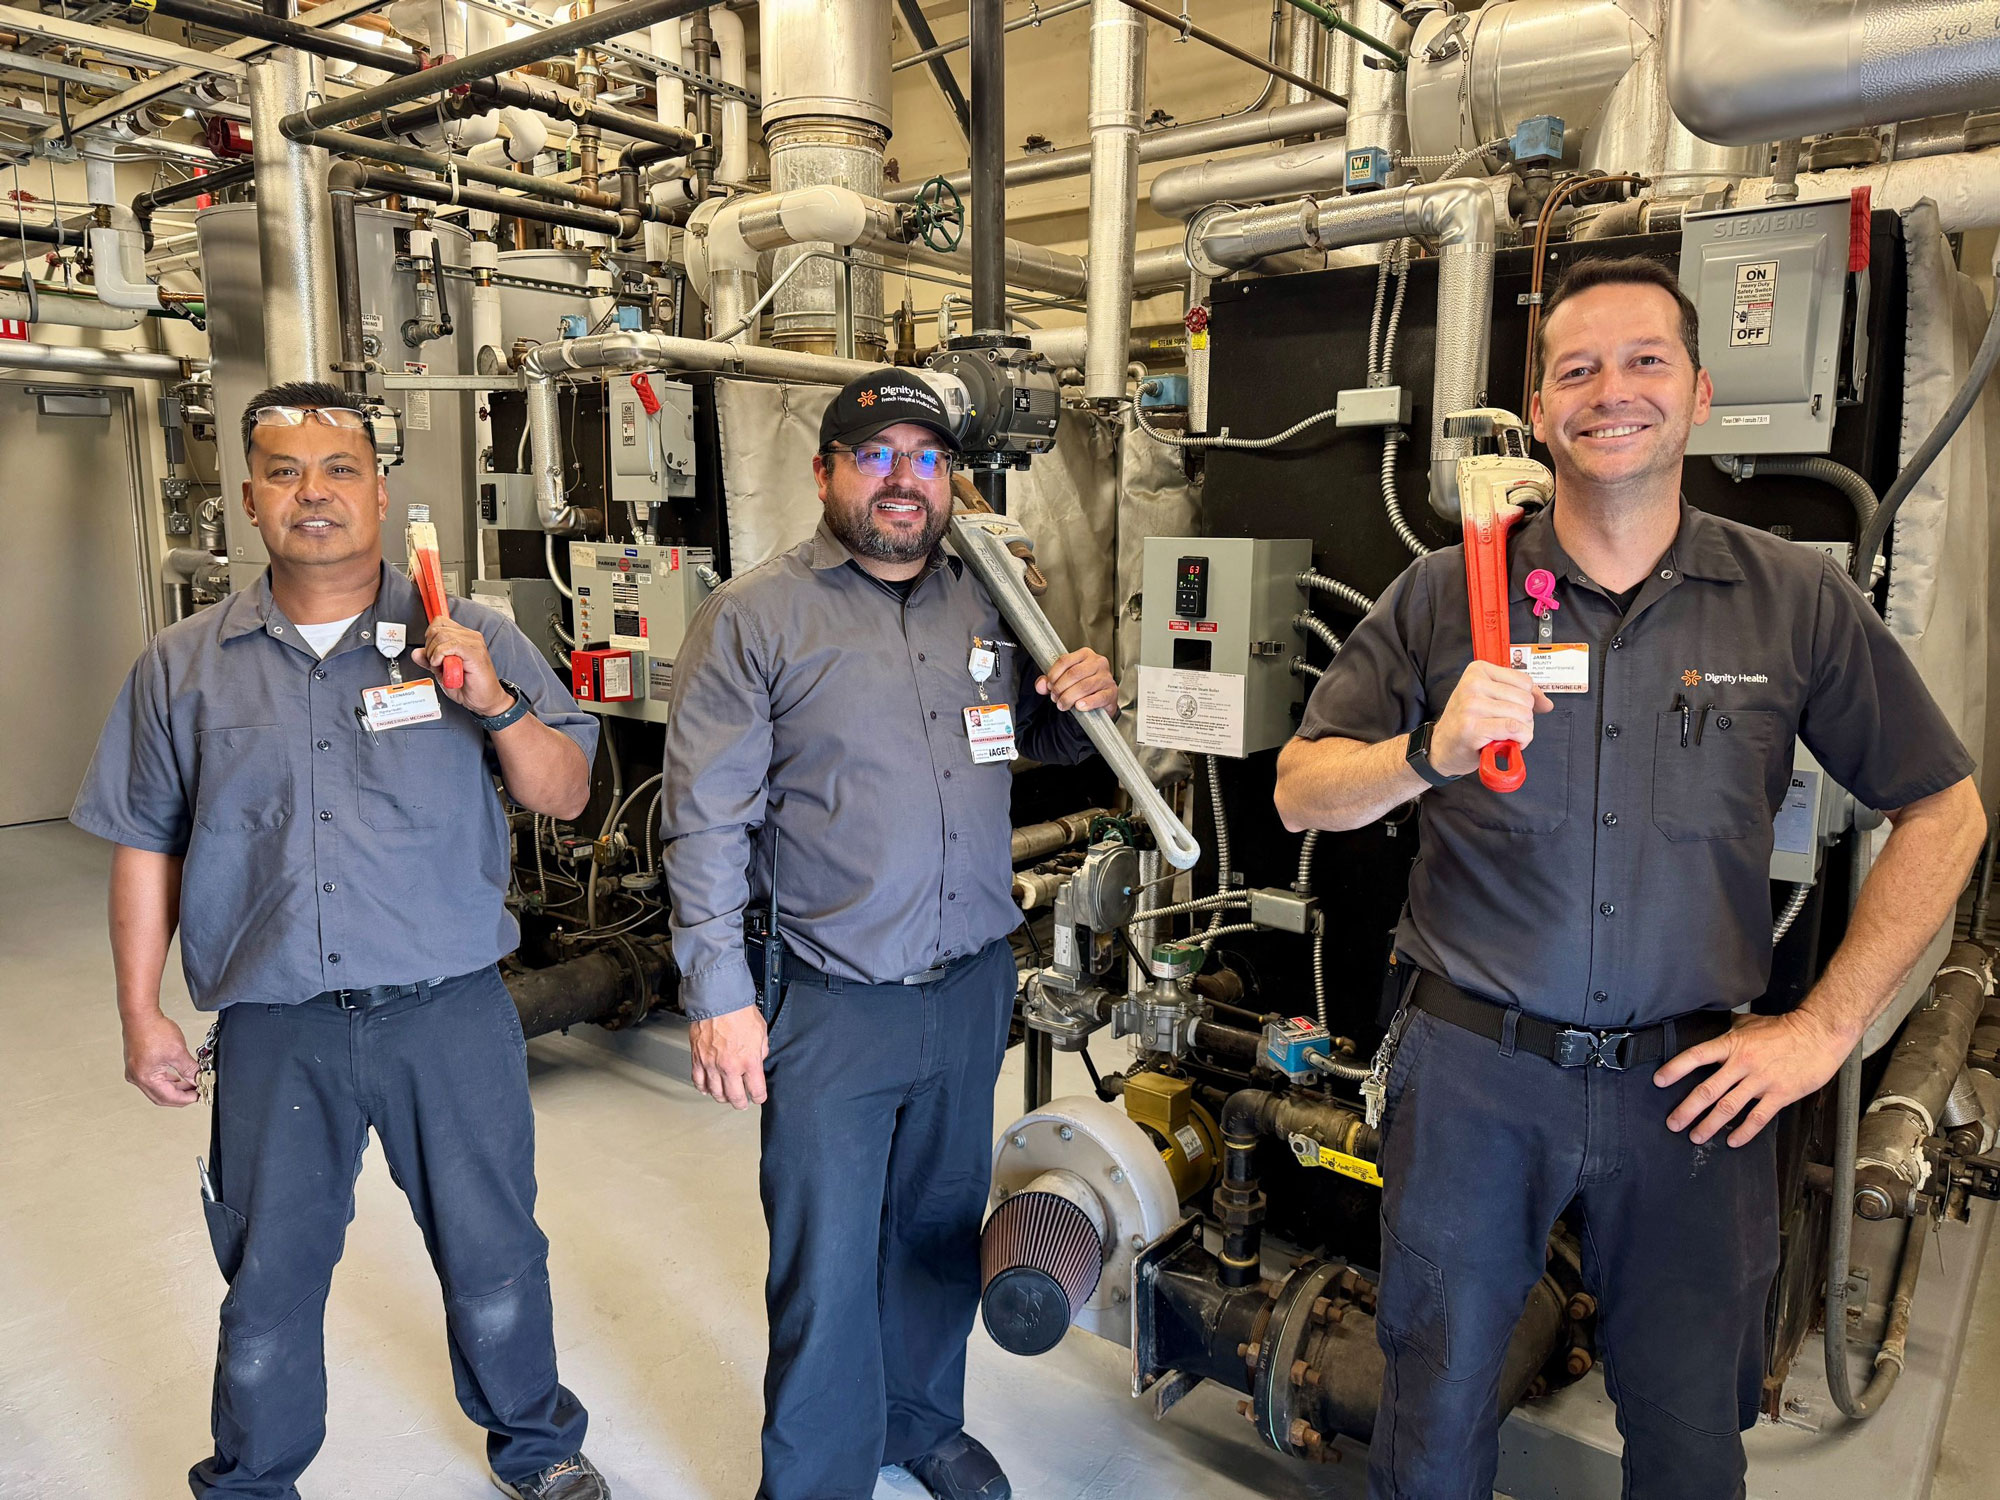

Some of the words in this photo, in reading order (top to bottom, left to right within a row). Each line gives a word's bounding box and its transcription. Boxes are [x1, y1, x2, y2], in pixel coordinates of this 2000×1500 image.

[1713, 210, 1817, 239] SIEMENS
[1746, 269, 1767, 281] ON
[1736, 328, 1765, 340] OFF
[880, 385, 915, 397] Dignity
[915, 388, 939, 407] Health
[659, 550, 668, 559] #1
[1189, 565, 1200, 574] 63
[1704, 673, 1738, 685] Dignity
[1738, 673, 1768, 684] Health
[376, 717, 410, 728] ENGINEERING
[410, 712, 435, 722] MECHANIC
[1791, 778, 1806, 788] Co.
